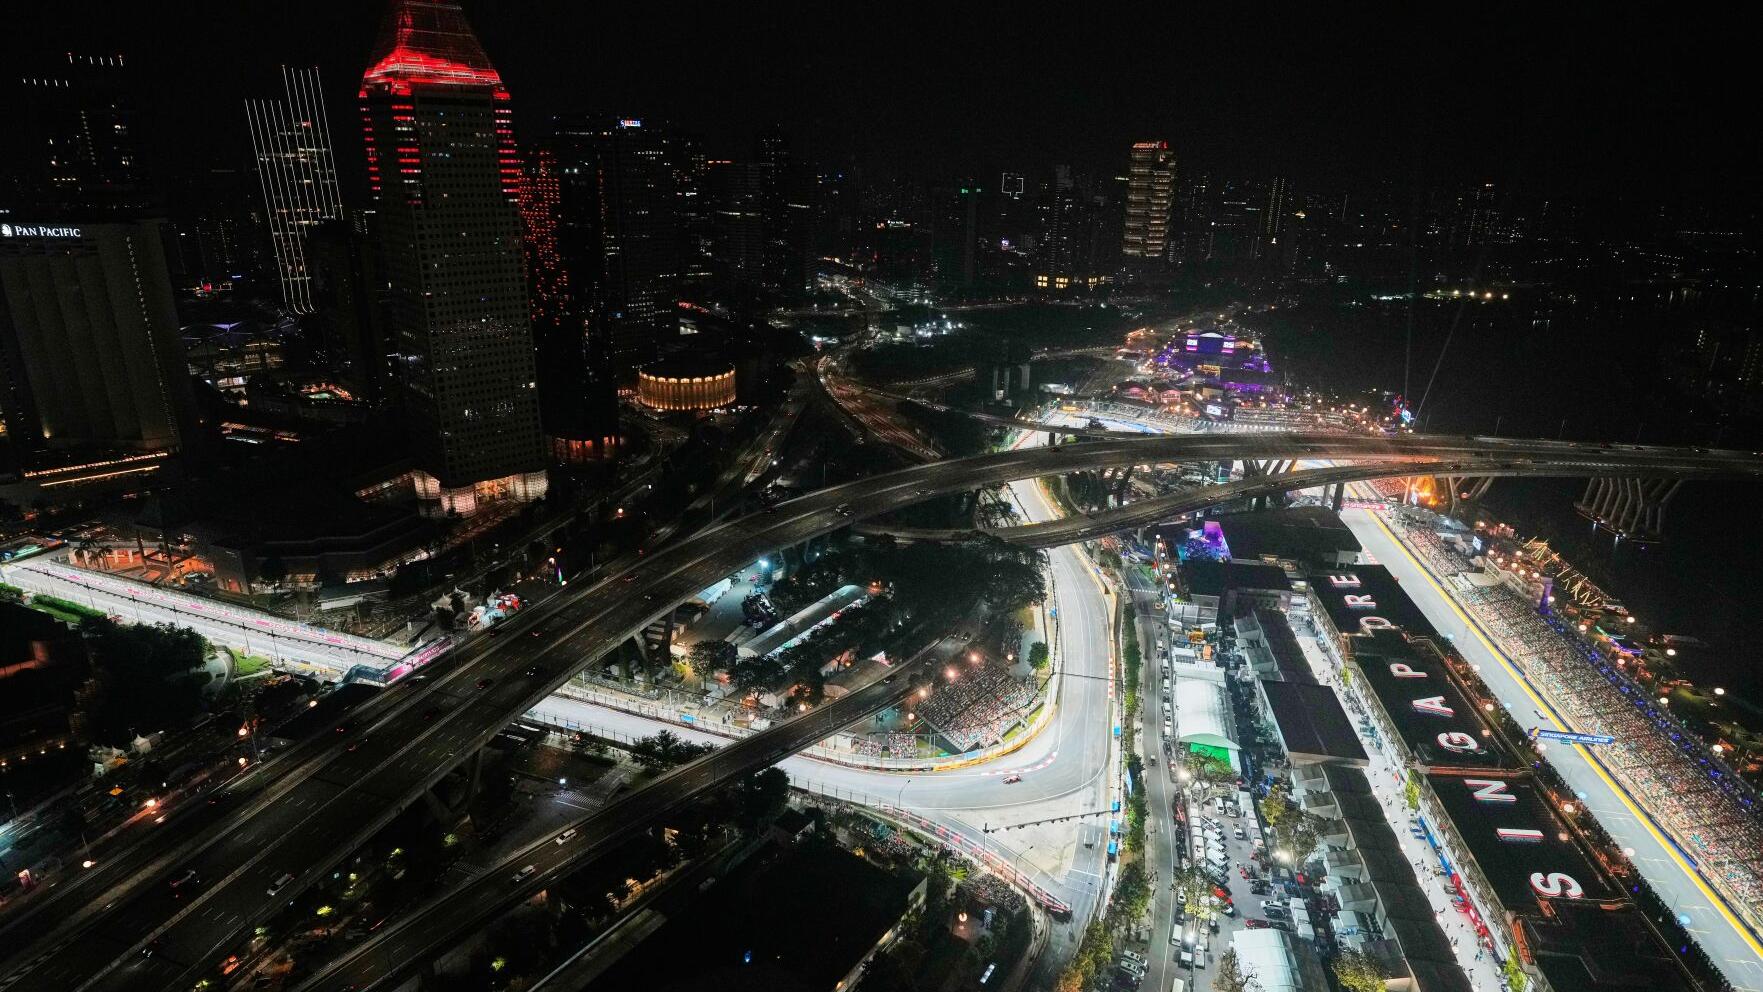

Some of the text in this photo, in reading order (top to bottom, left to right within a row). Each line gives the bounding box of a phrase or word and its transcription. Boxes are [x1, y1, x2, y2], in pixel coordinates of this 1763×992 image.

[15, 226, 81, 237] PAN PACIFIC
[1328, 575, 1585, 899] SINGAPORE
[1540, 732, 1578, 740] SINGAPORE
